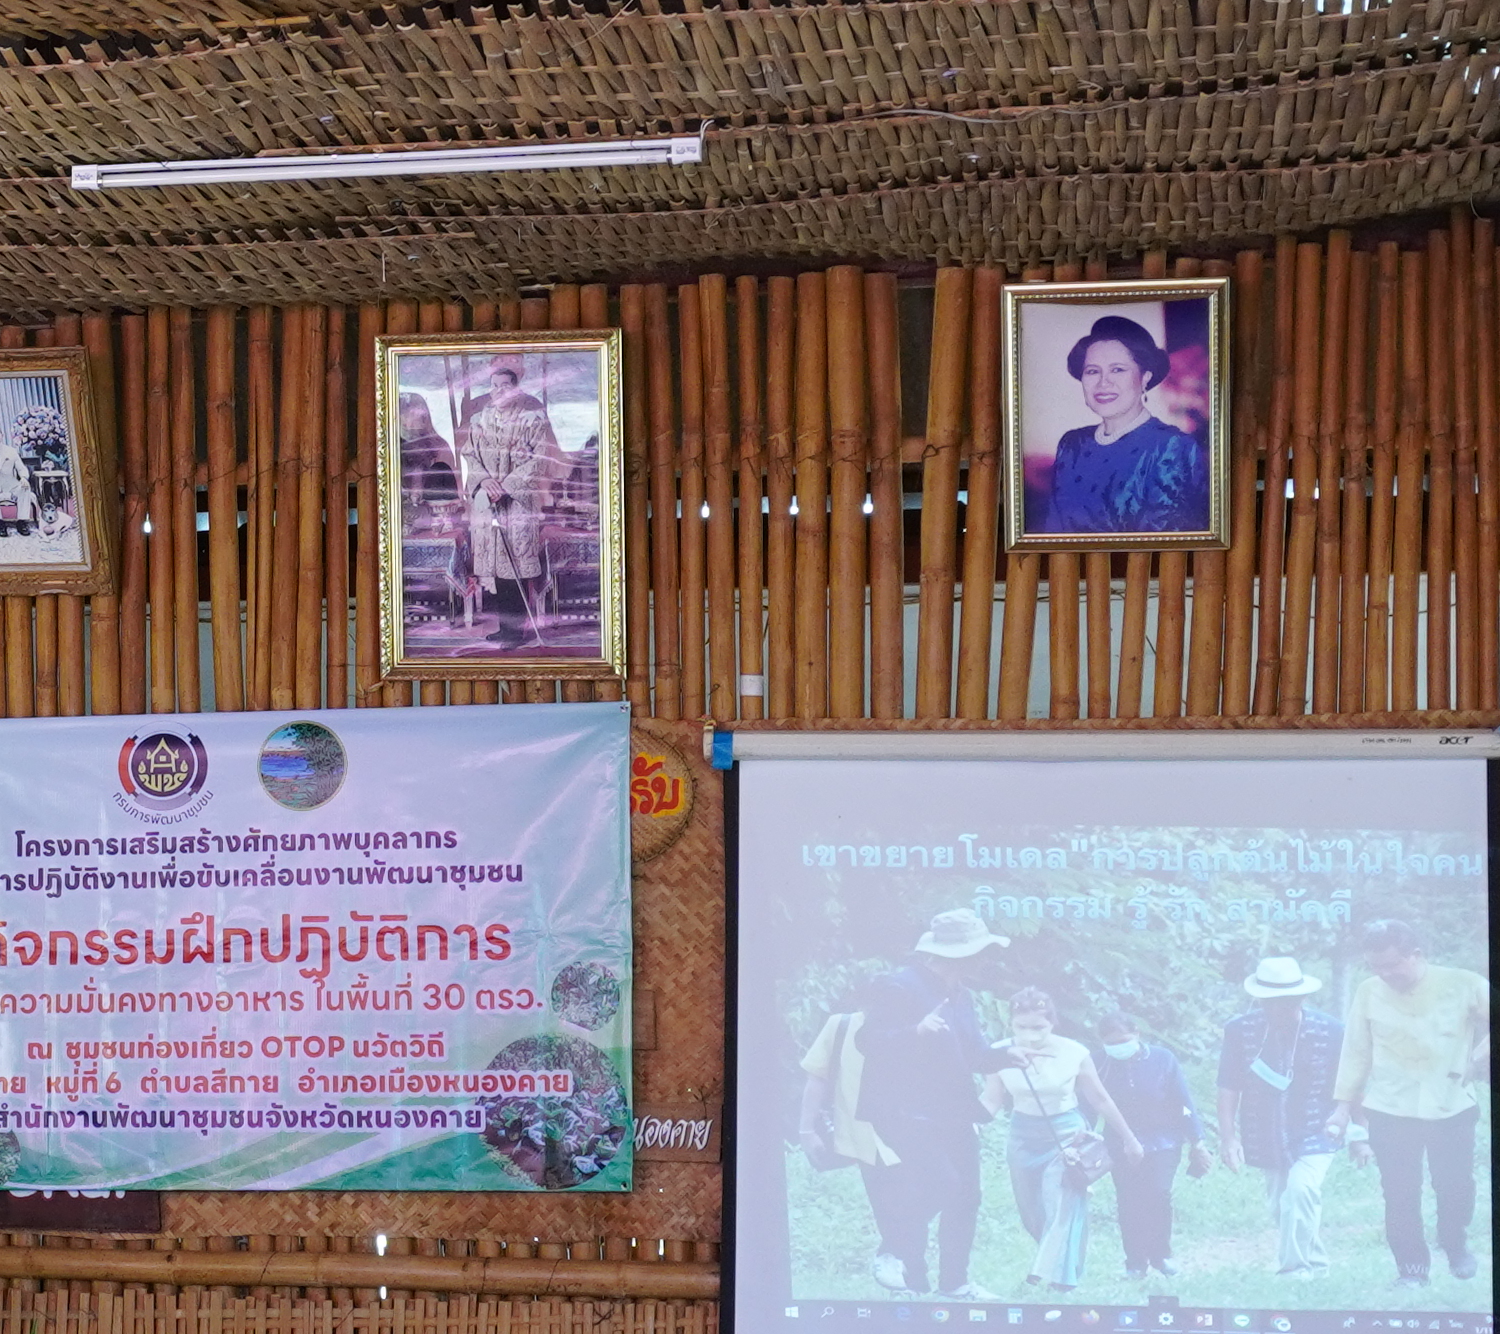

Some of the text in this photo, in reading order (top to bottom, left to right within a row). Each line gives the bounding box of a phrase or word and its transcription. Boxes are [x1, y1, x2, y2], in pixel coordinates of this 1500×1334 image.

[1439, 736, 1473, 745] acer
[112, 789, 214, 825] กรมการพัฒนาชุมชน
[15, 827, 458, 857] โครงการเสริมสร้างศักยภาพบุคลากร
[972, 885, 1113, 919] กิจกรรม
[1226, 887, 1352, 923] สามัคคี
[313, 973, 413, 1011] ในพื้นที่
[422, 983, 466, 1011] 30
[475, 987, 544, 1011] ตรว.
[27, 1027, 445, 1066] ณ ชุมชนท่องเที่ยว OTOP นวัตวิถี
[47, 1061, 99, 1102] หมู่ที่
[105, 1071, 122, 1095] 6
[141, 1068, 280, 1095] ตำบลสีกาย
[298, 1067, 570, 1095] อำเภอเมืองหนองคาย
[632, 1114, 714, 1152] นองคาย
